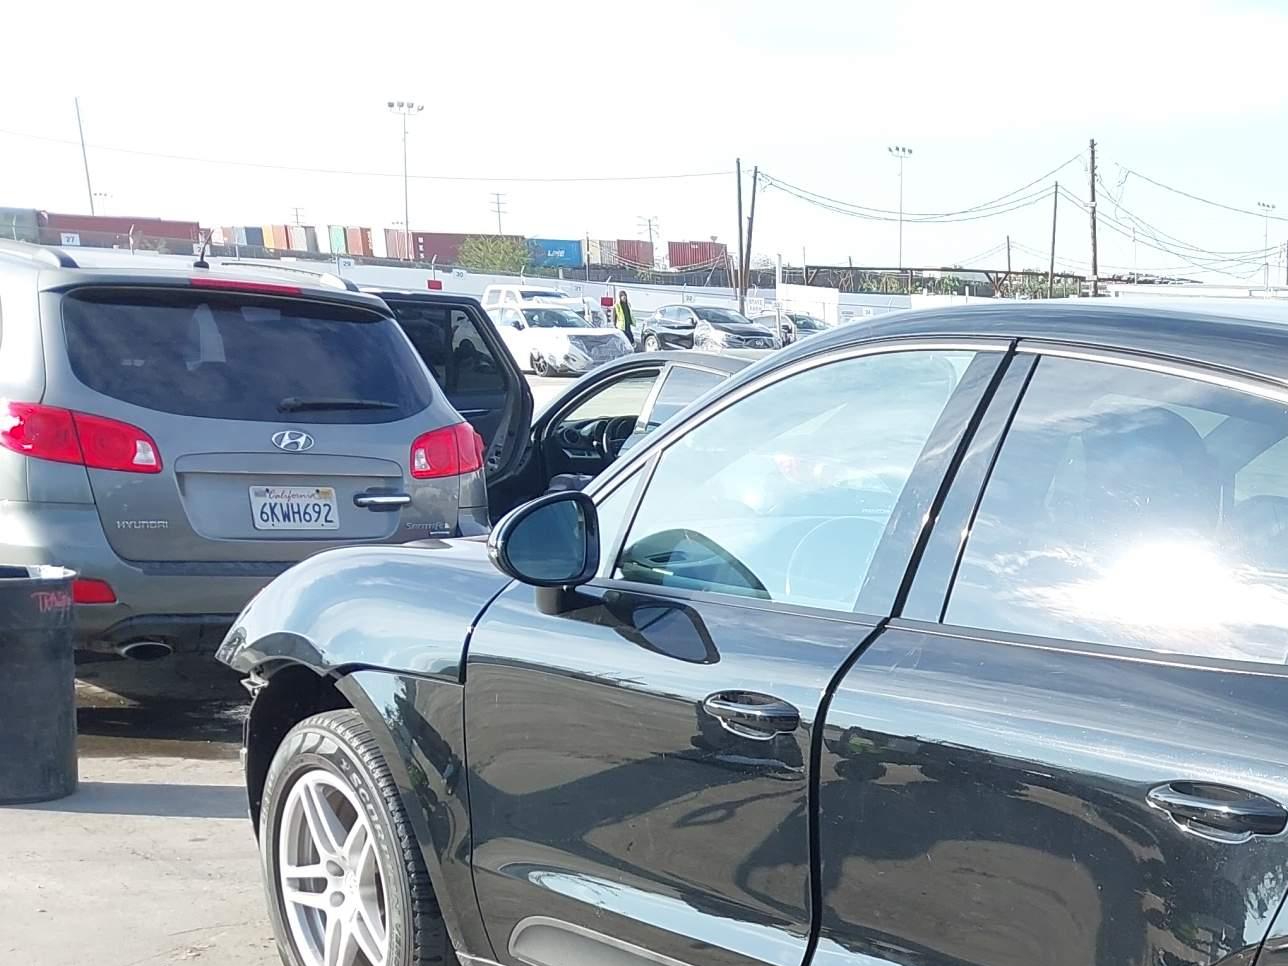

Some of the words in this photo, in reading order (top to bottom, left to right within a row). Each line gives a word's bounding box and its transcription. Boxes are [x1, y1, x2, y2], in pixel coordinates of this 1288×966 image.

[267, 485, 316, 502] California
[260, 502, 333, 524] 6KWH692
[116, 520, 169, 529] HYUNDAI
